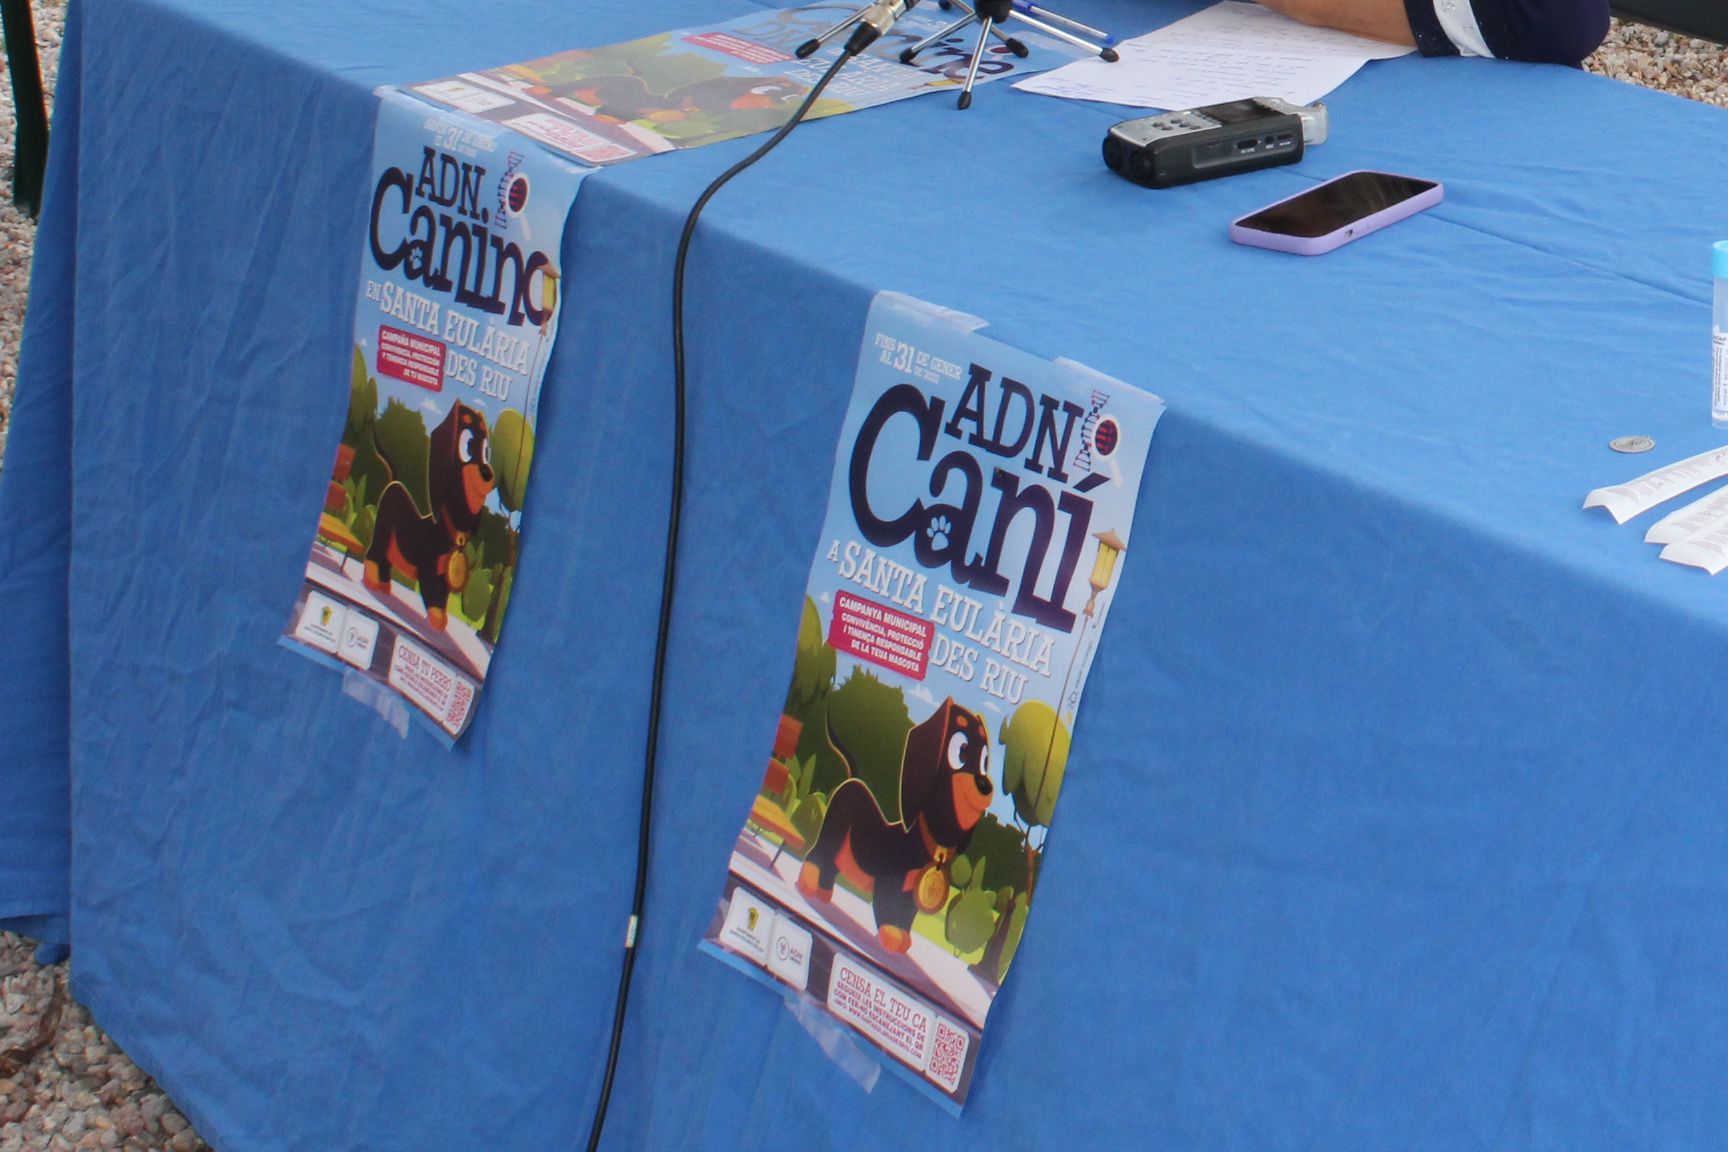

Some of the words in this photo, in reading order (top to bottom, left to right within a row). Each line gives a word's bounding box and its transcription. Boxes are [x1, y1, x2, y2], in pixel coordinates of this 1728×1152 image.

[416, 146, 486, 220] ADN
[370, 167, 556, 326] Canino
[366, 280, 381, 303] EN
[380, 281, 440, 336] SANTA
[444, 309, 530, 376] EULÀRIA
[893, 341, 915, 374] 31
[445, 349, 479, 388] DES
[480, 366, 512, 401] RIU
[944, 362, 1084, 483] ADN
[849, 383, 1111, 634] Caní
[826, 540, 841, 563] A
[838, 540, 928, 614] SANTA
[929, 585, 1056, 677] EULÀRIA
[840, 596, 882, 621] CAMPANYA
[883, 612, 927, 637] MUNICIPAL
[887, 629, 924, 650] PROTECCIÓ
[930, 632, 979, 681] DES
[980, 658, 1029, 705] RIU
[840, 967, 872, 998] CENSA
[873, 988, 886, 1007] EL
[889, 997, 911, 1021] TEU
[912, 1013, 927, 1033] CA
